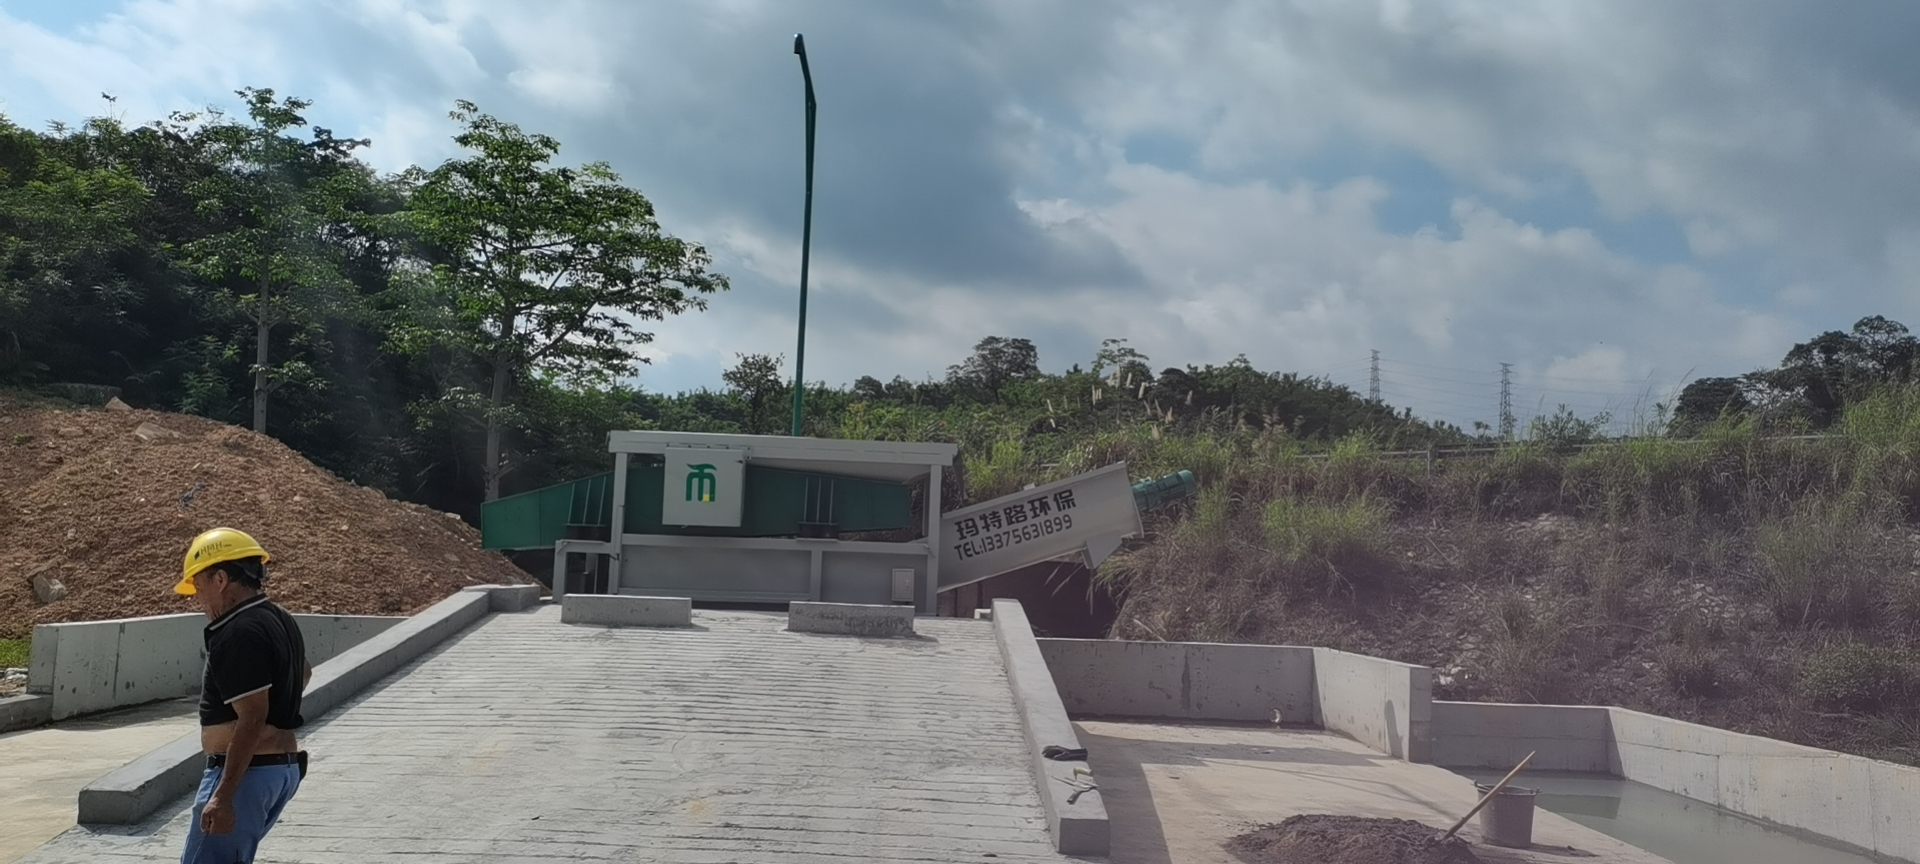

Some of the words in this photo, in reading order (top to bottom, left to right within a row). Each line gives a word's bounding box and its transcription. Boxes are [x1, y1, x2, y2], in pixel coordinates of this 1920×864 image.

[954, 489, 1076, 540] 玛特路环保
[954, 514, 1073, 561] TEL:13375631899
